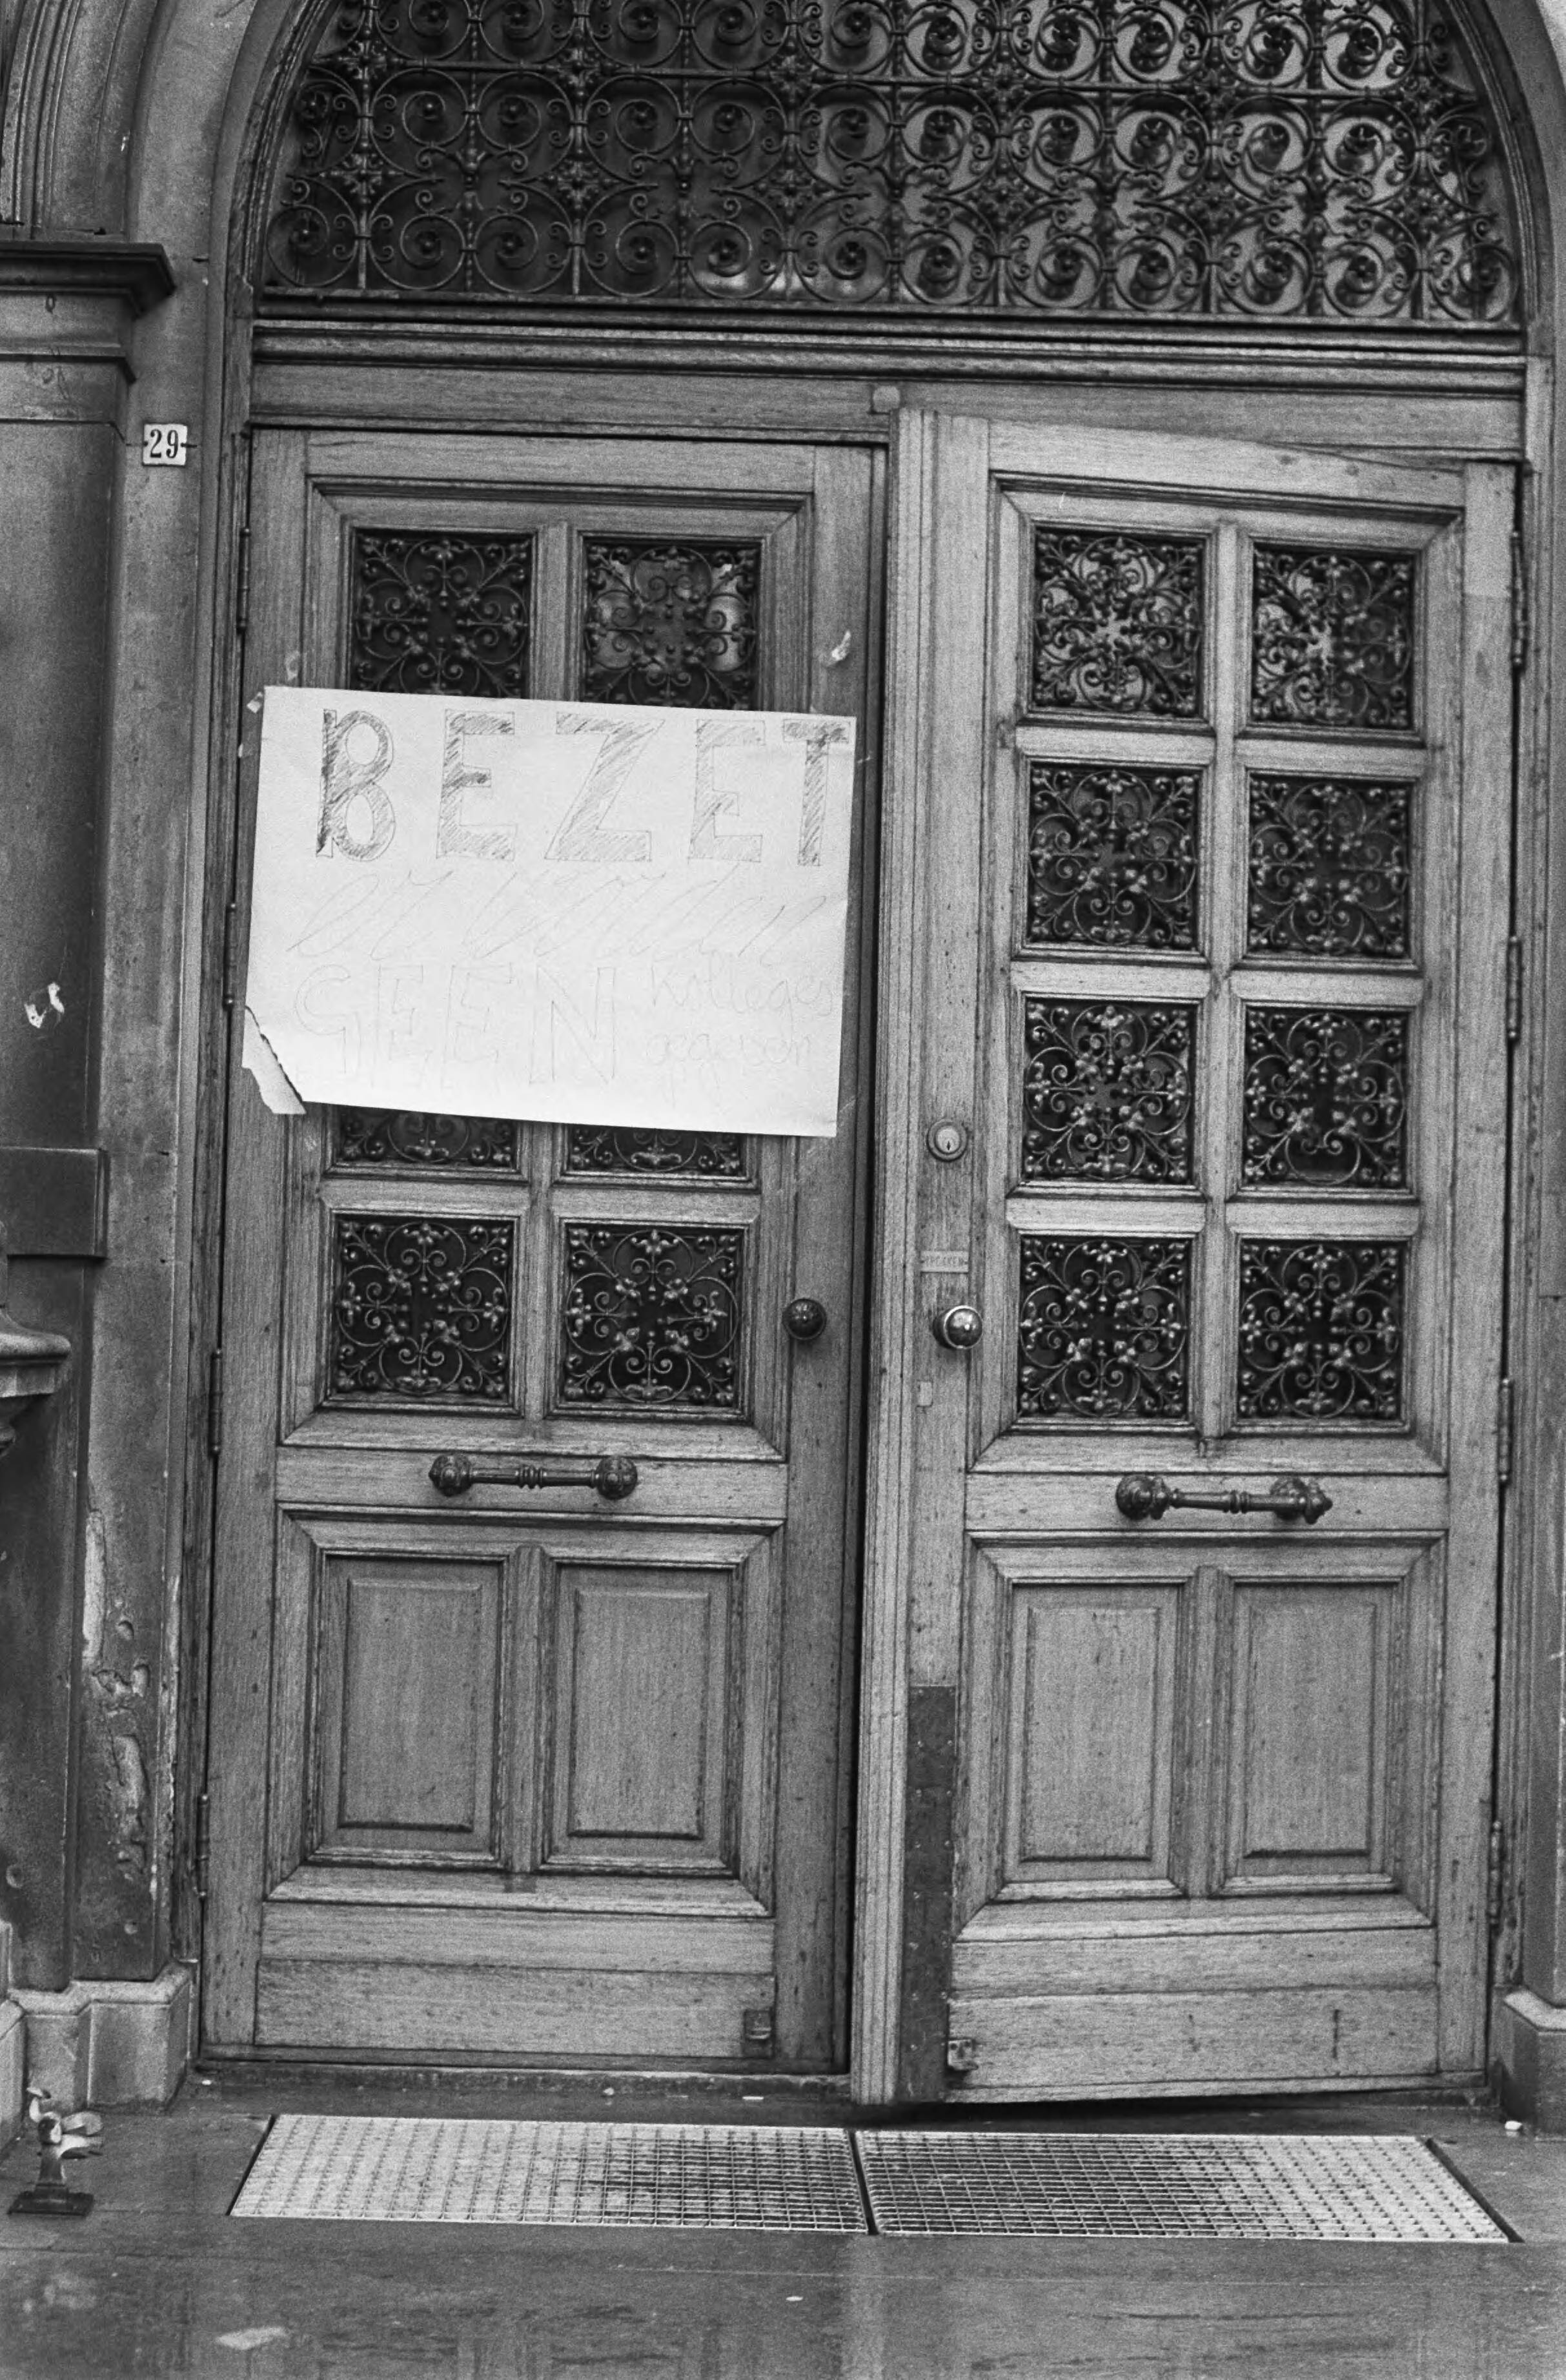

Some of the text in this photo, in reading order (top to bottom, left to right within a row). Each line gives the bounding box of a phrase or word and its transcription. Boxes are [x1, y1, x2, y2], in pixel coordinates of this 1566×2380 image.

[150, 429, 179, 458] 29
[315, 708, 853, 867] BEZET
[293, 963, 618, 1089] GEEN
